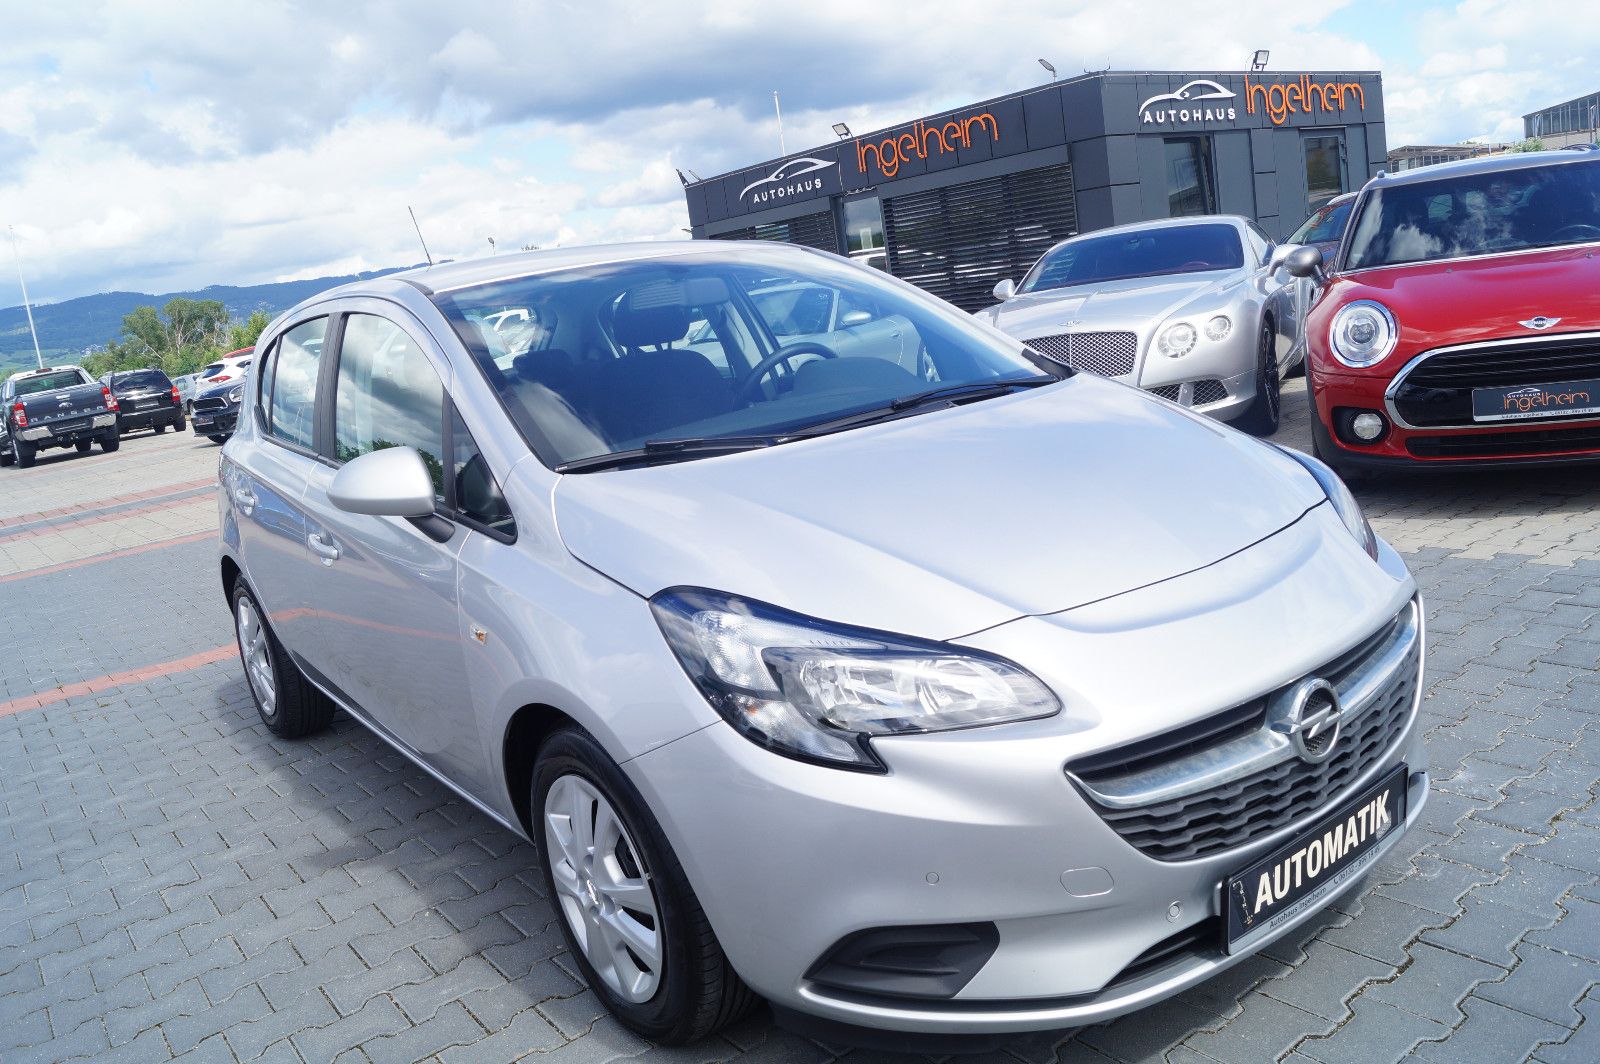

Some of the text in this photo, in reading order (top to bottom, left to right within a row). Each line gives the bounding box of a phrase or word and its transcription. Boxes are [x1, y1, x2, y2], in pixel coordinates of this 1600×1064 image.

[1143, 107, 1237, 124] AUTOHAUS
[1244, 74, 1365, 125] Ingelheim
[856, 113, 999, 177] Ingelheim
[753, 178, 822, 204] AUTOHAUS
[1253, 789, 1390, 914] AUTOMATIK
[1269, 906, 1298, 929] Autohaus
